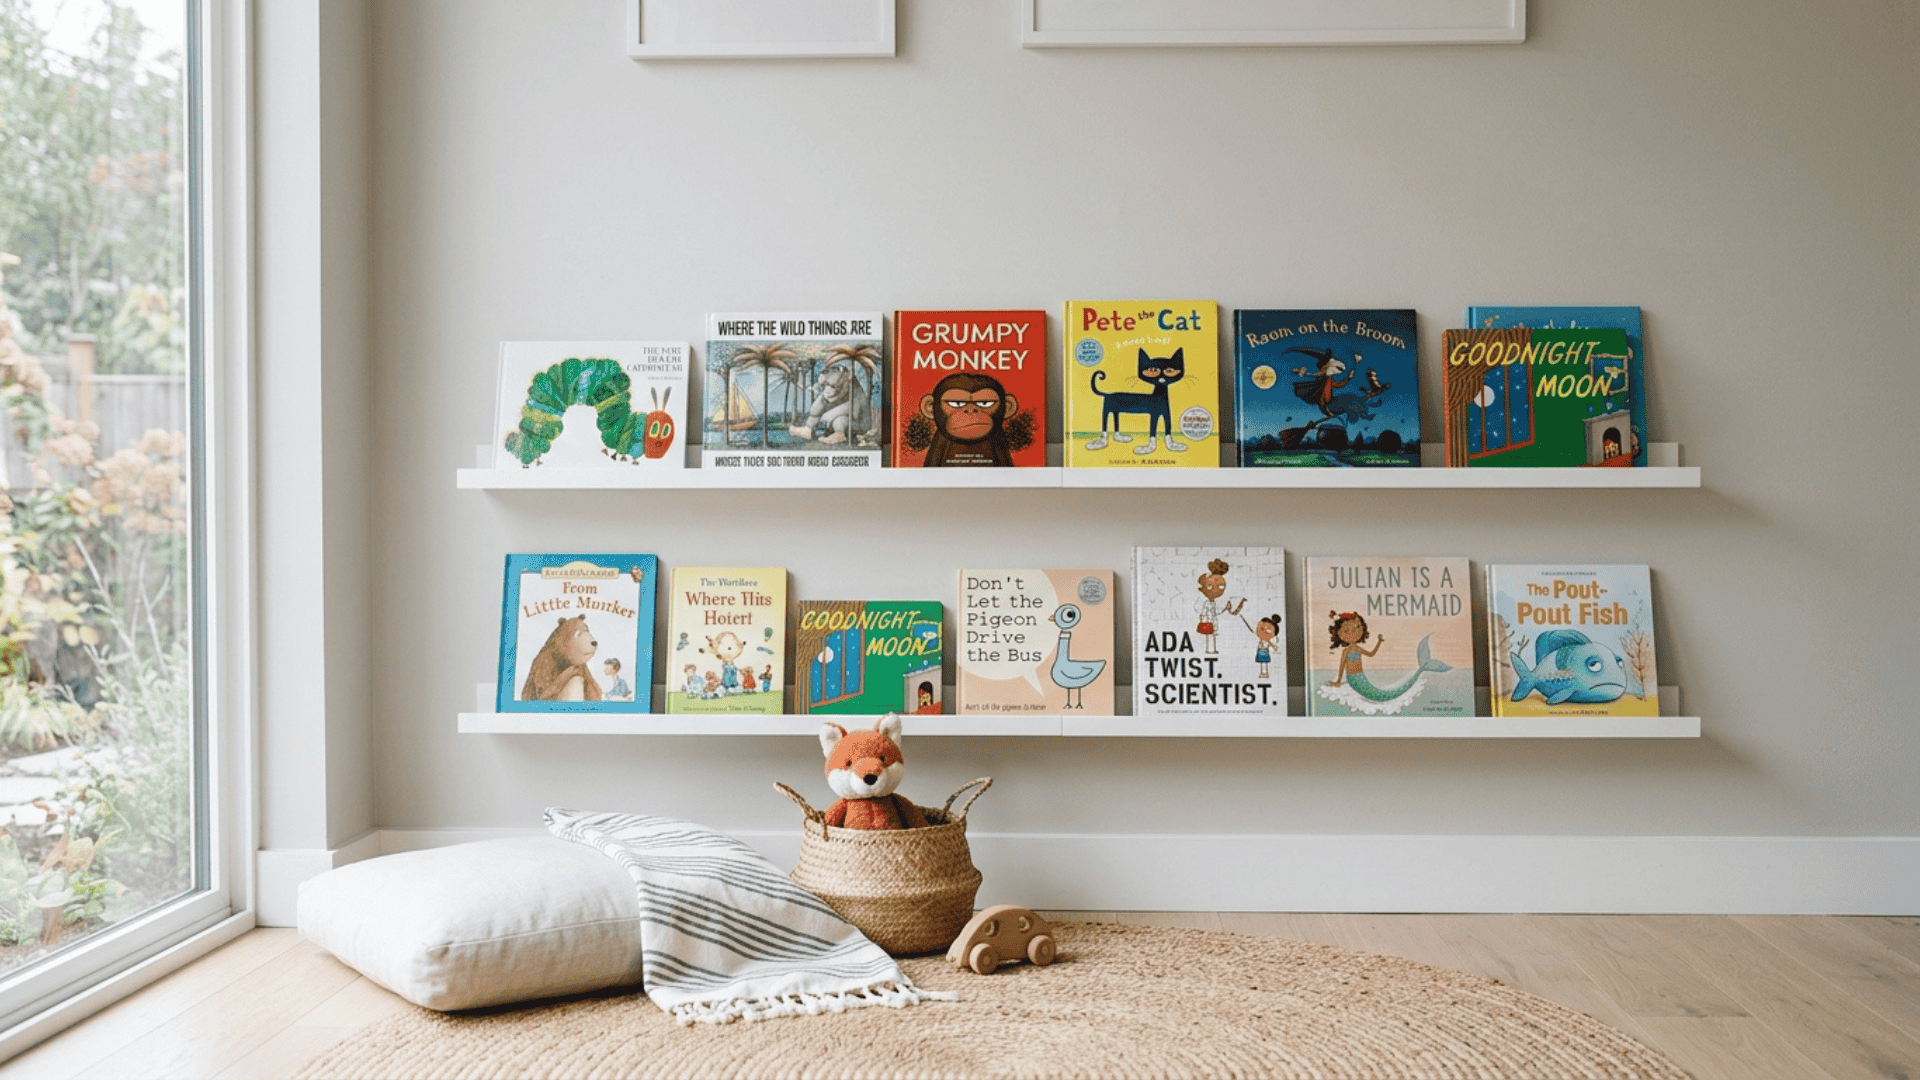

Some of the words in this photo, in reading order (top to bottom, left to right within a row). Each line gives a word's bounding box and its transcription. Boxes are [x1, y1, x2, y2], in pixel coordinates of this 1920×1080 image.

[718, 320, 755, 336] WHERE
[757, 320, 777, 336] THE
[1082, 307, 1137, 331] Pete
[1158, 308, 1202, 331] Cat
[912, 322, 1030, 344] GRUMPY
[1298, 322, 1319, 334] on
[1322, 319, 1349, 333] the
[1356, 321, 1406, 349] Broom
[912, 350, 1029, 370] MONKEY
[1450, 341, 1602, 366] GOODNIGHT
[1536, 374, 1613, 398] MOON
[967, 576, 1024, 590] Don't
[1327, 566, 1401, 589] JULIAN
[1411, 566, 1431, 589] IS
[1440, 566, 1454, 589] A
[685, 591, 736, 606] Where
[1526, 583, 1550, 596] The
[1553, 579, 1609, 599] Pout-
[967, 594, 1001, 608] Let
[1010, 594, 1043, 608] the
[1366, 594, 1463, 617] MERMAID
[967, 612, 1037, 629] Pigeon
[1517, 601, 1572, 625] Pout
[1579, 601, 1628, 625] Fish
[866, 637, 929, 657] MOON
[966, 630, 1026, 644] Drive
[1144, 631, 1194, 652] ADA
[967, 648, 1001, 662] the
[1007, 648, 1043, 662] Bus
[1144, 657, 1222, 678] TWIST.
[1144, 683, 1277, 706] SCIENTIST.
